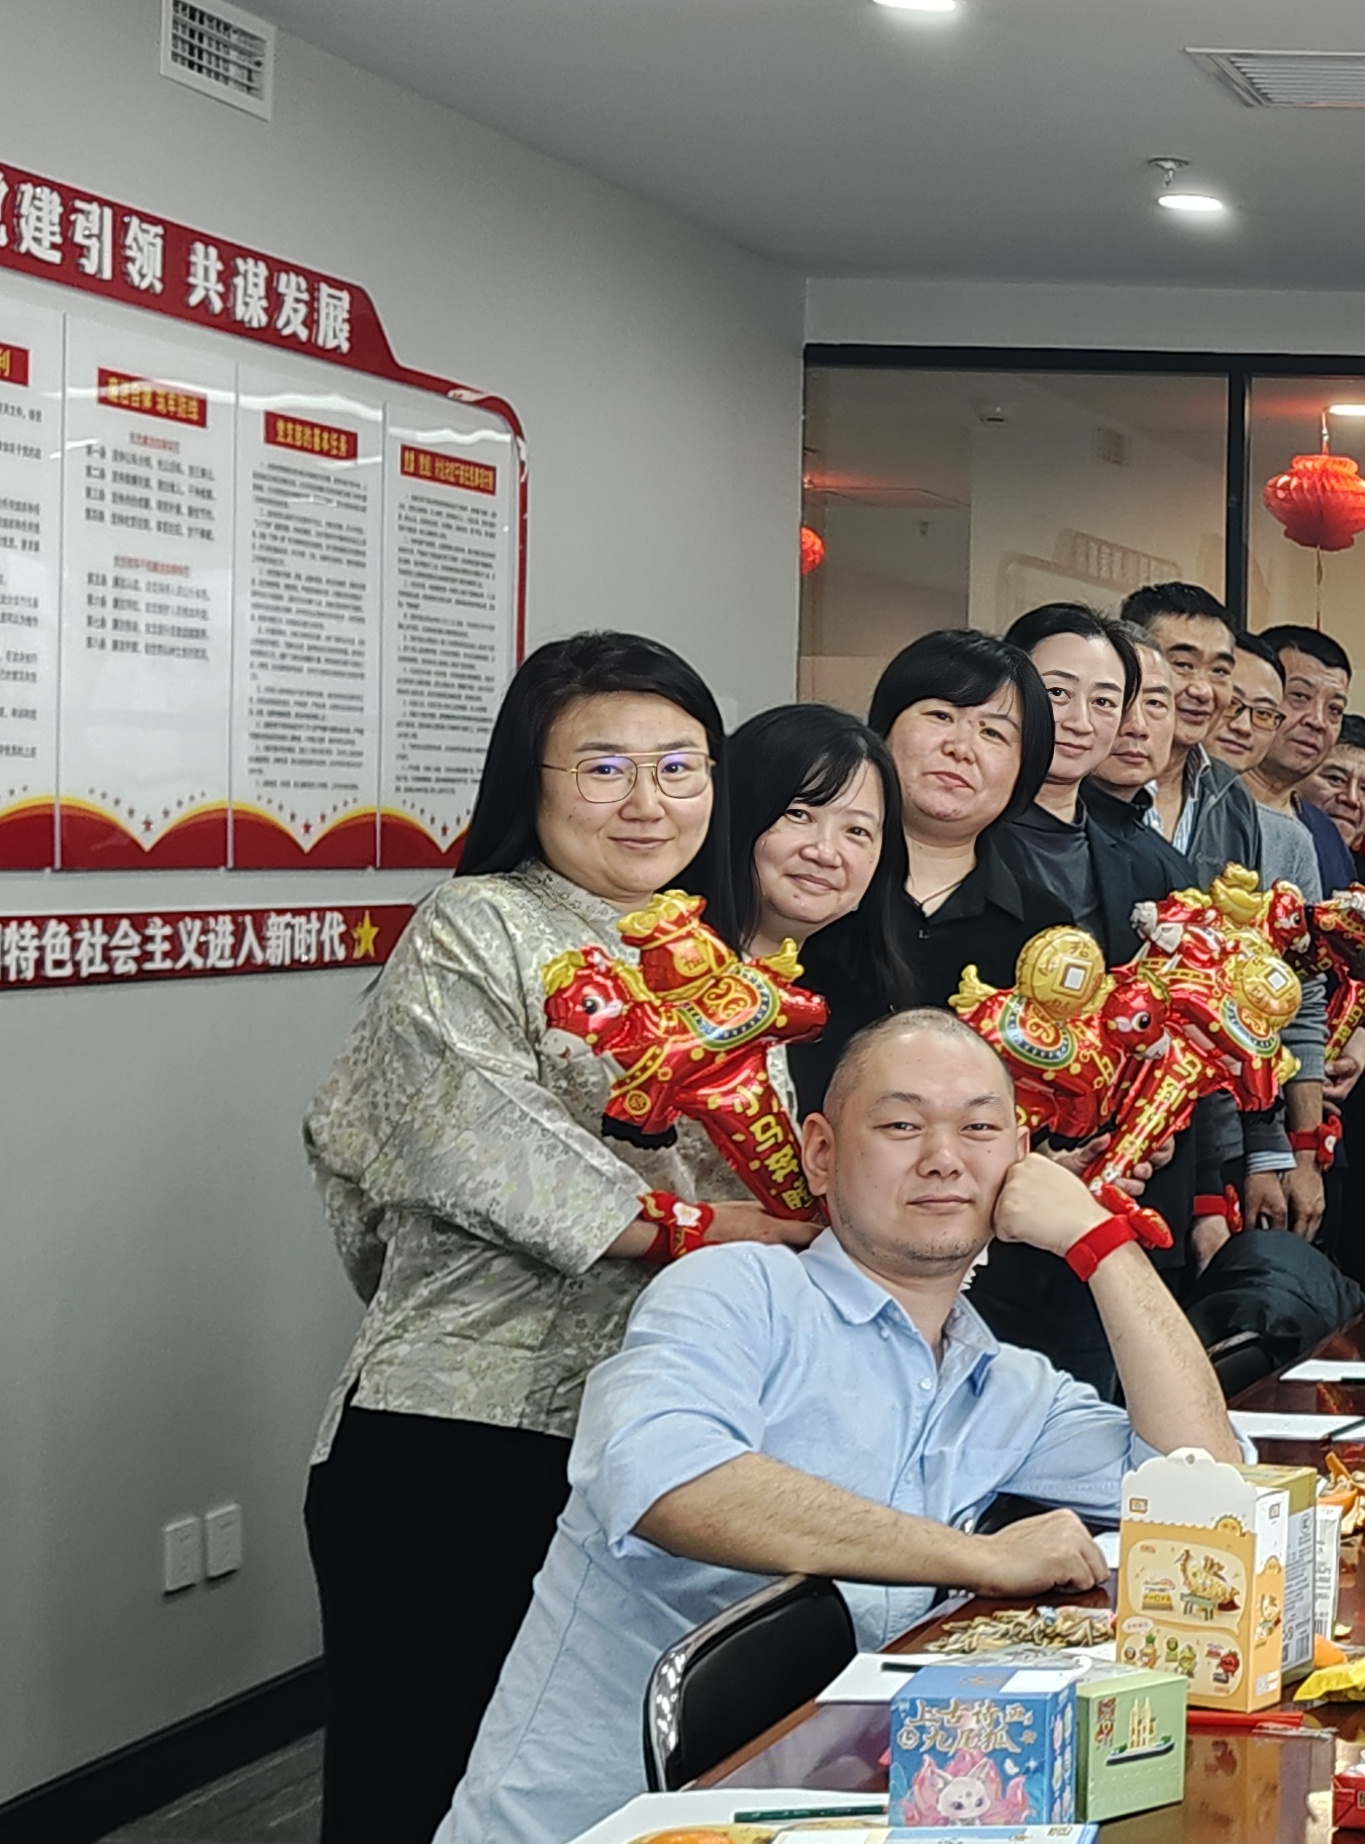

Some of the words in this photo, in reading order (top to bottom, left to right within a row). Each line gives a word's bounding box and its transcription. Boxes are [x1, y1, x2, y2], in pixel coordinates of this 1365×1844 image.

[0, 172, 165, 294] 建引领
[186, 242, 352, 354] 共谋发展
[2, 911, 348, 982] 特色社会主义进入新时代
